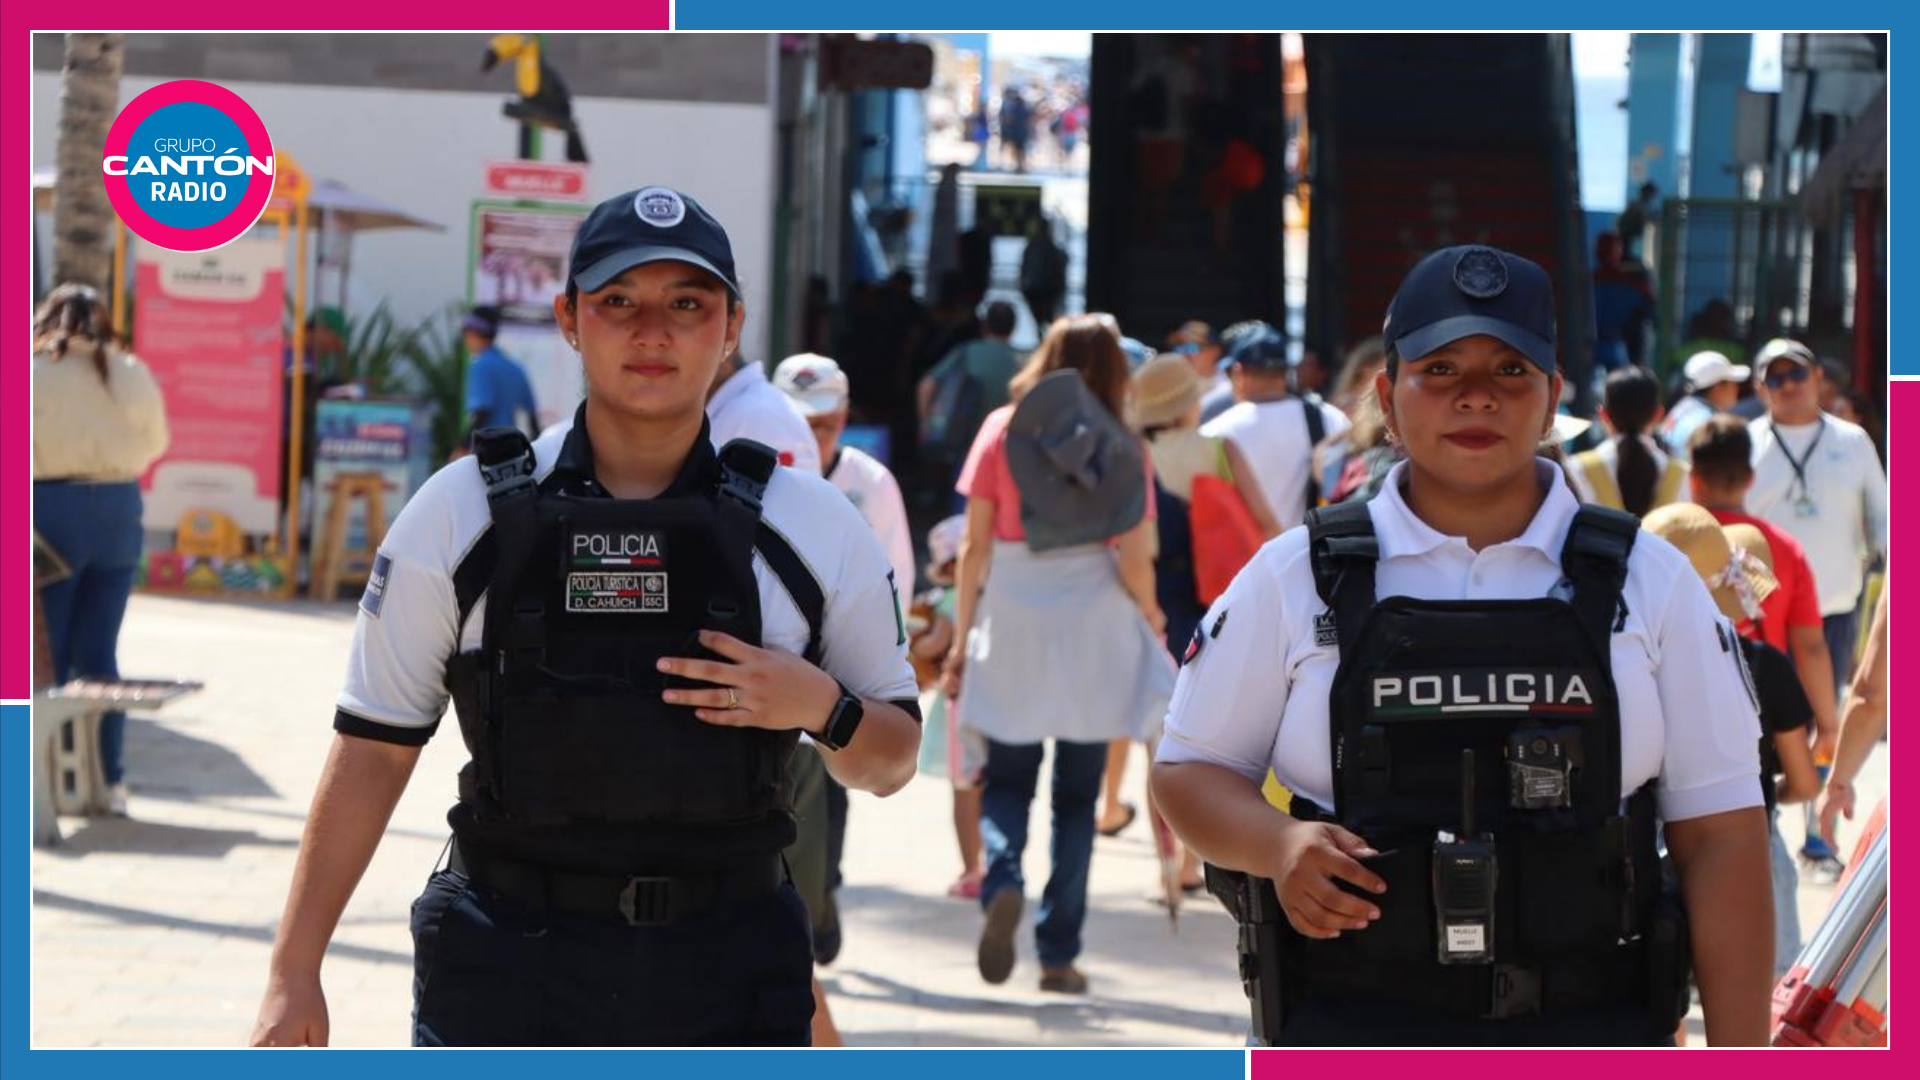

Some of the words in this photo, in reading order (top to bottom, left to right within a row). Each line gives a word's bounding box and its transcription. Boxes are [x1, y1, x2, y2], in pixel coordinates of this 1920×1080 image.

[573, 534, 660, 556] POLICIA
[588, 598, 636, 608] CAHUICH
[645, 597, 663, 607] SSC
[1373, 673, 1592, 707] POLICIA
